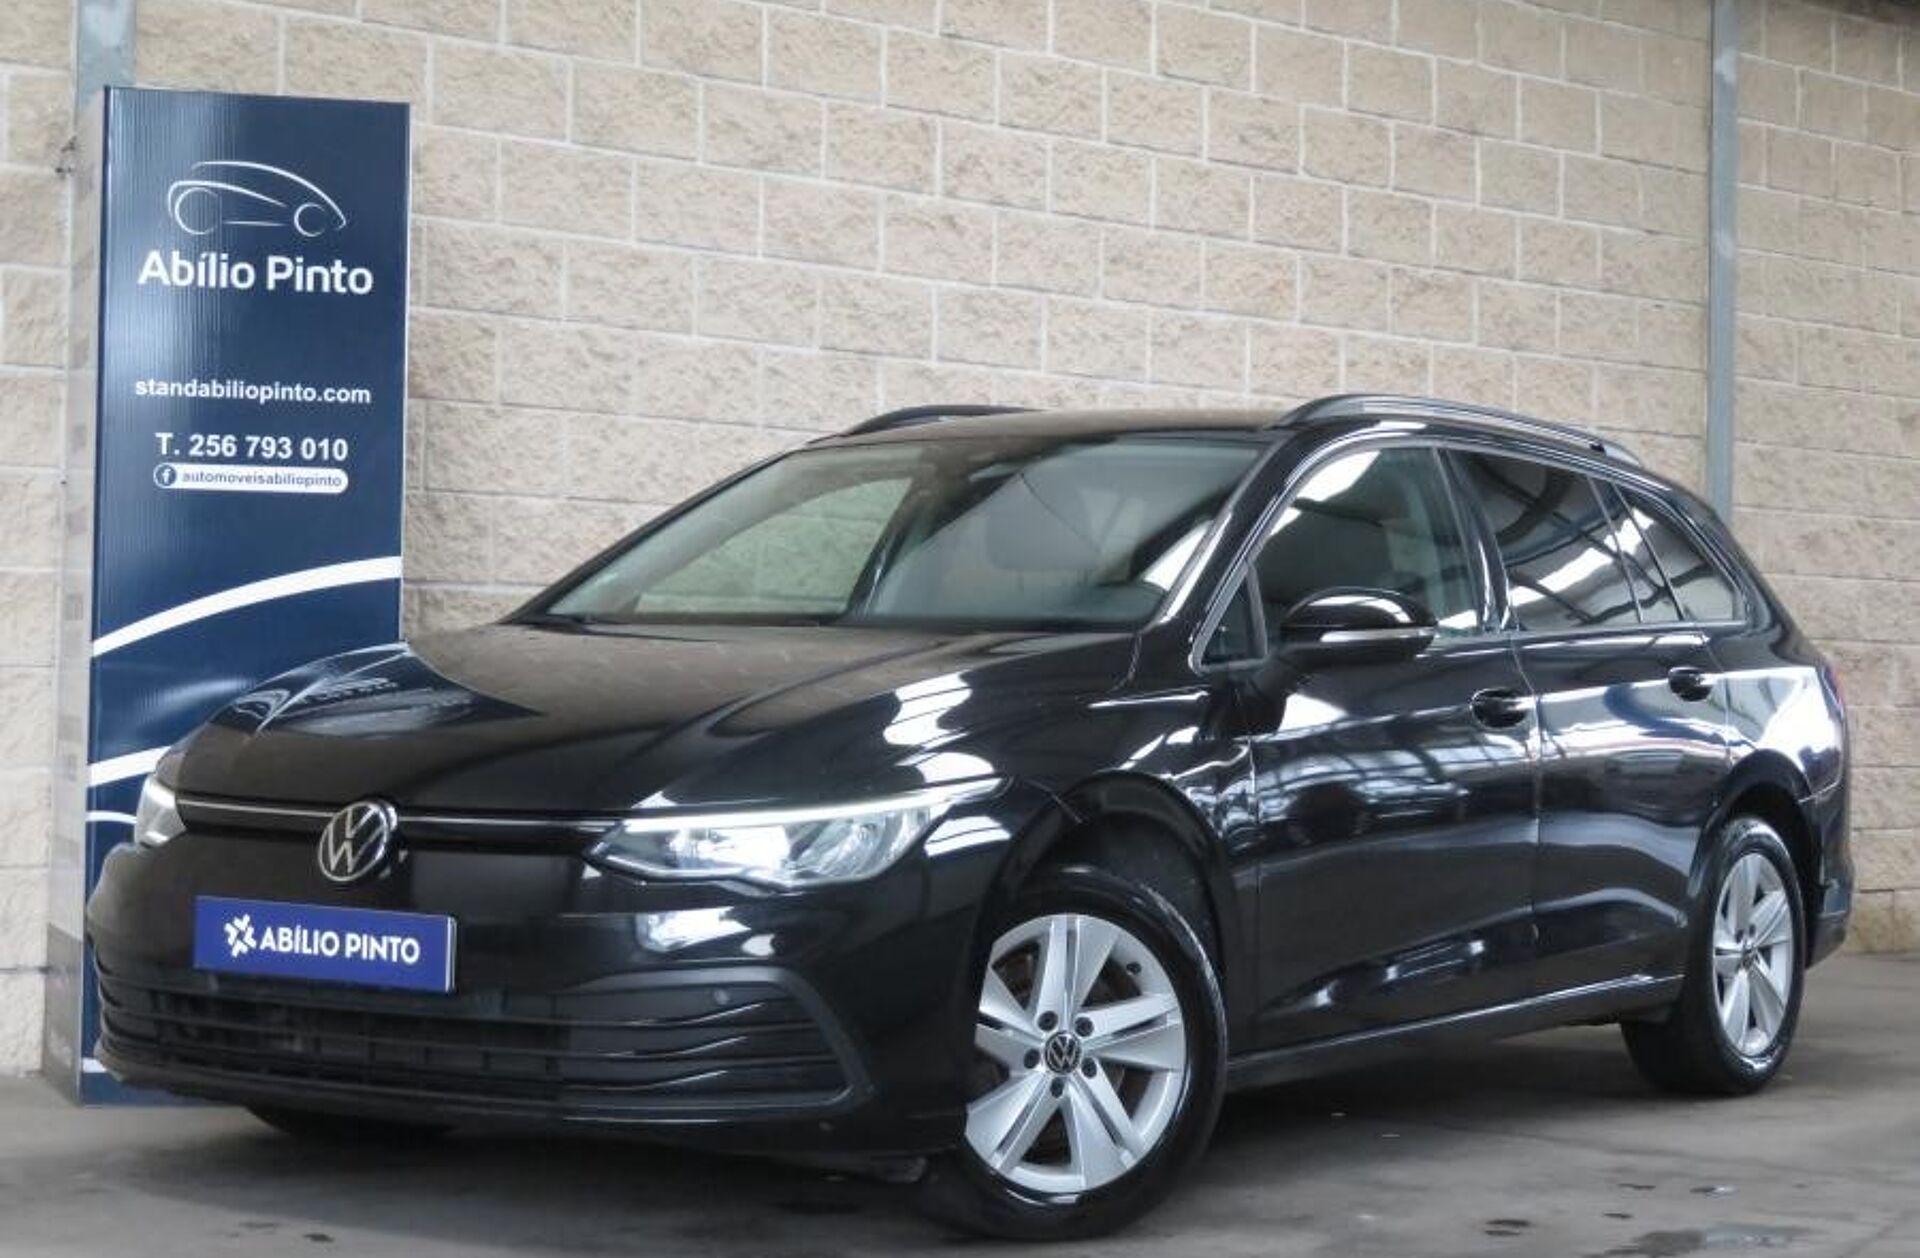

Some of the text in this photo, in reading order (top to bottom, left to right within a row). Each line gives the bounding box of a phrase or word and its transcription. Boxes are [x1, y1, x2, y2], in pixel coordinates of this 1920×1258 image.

[137, 250, 374, 294] Abílio Pinto
[135, 379, 371, 405] standabiliopinto.com
[155, 432, 349, 461] T. 256 793 010
[182, 470, 342, 488] automoveisabiliopinto
[259, 924, 421, 964] ABÍLIO PINTO
